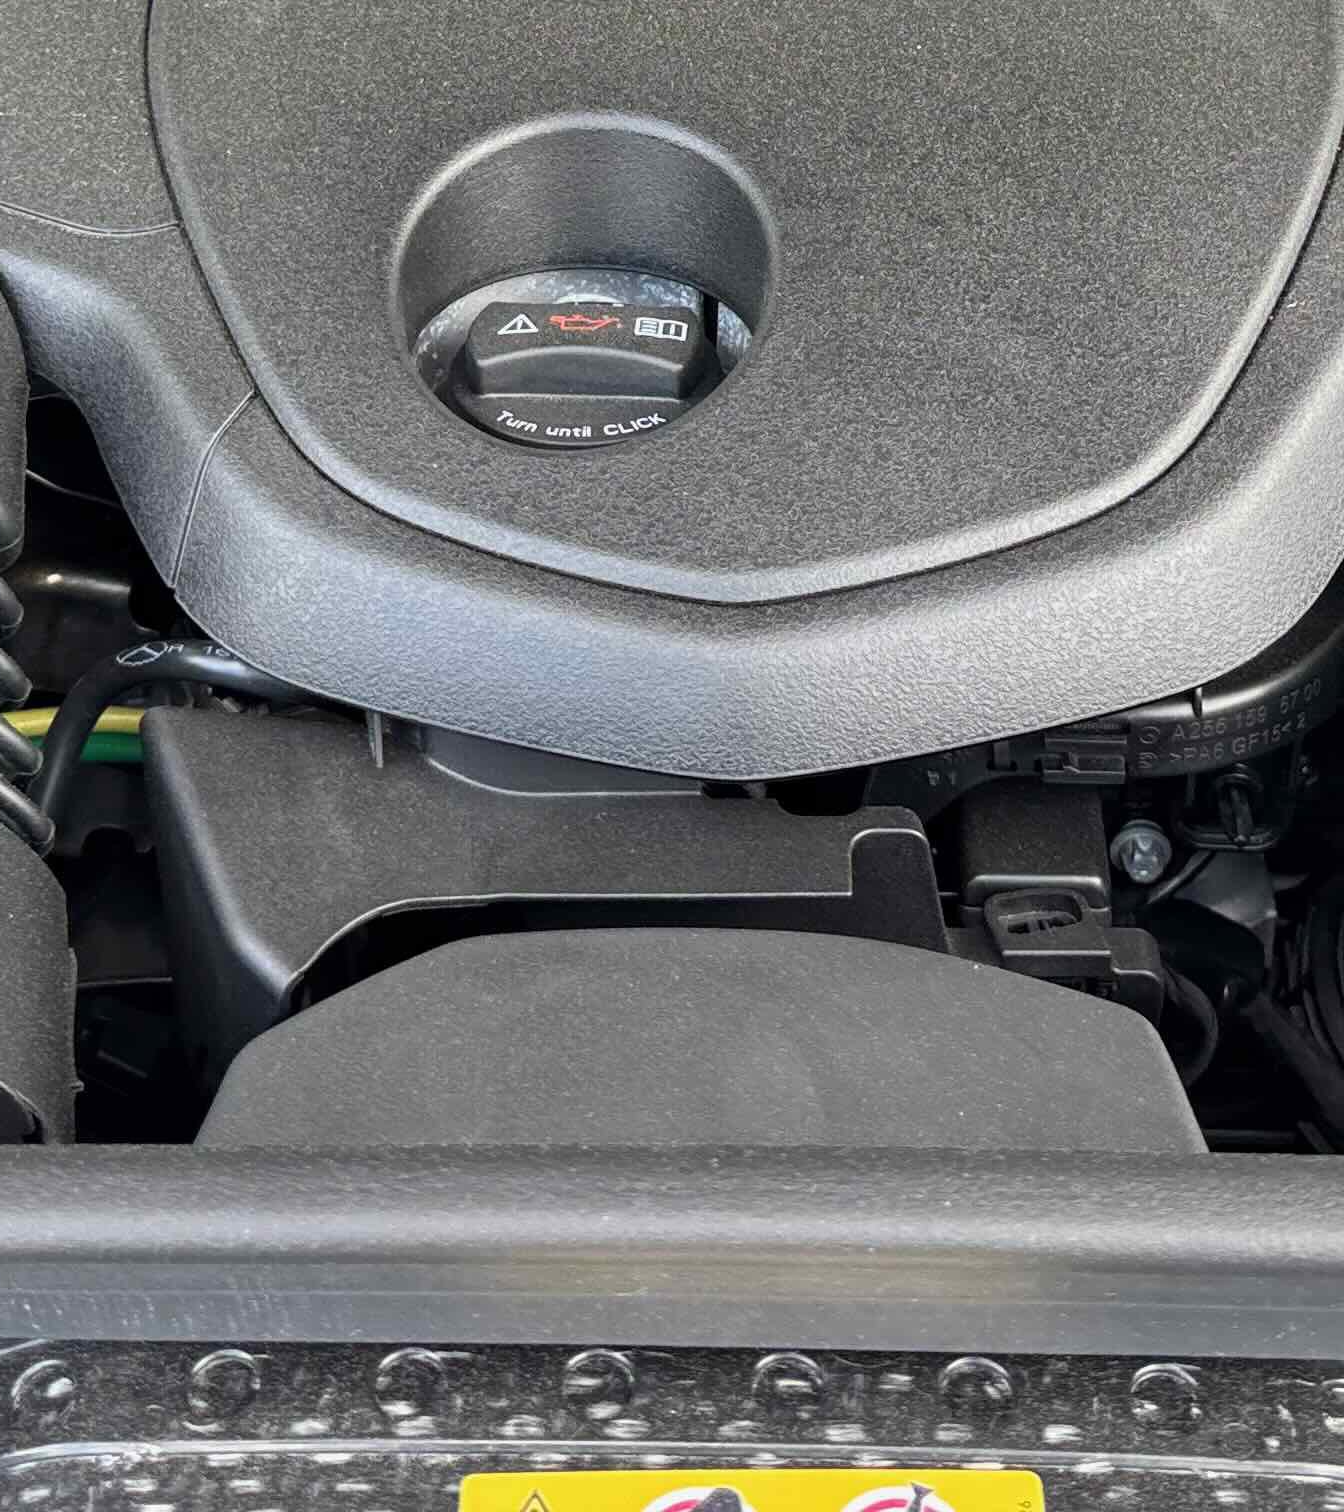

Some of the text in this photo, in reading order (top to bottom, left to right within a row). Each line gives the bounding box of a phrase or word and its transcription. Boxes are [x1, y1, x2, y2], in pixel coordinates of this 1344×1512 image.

[497, 410, 667, 438] Turn until CLICK
